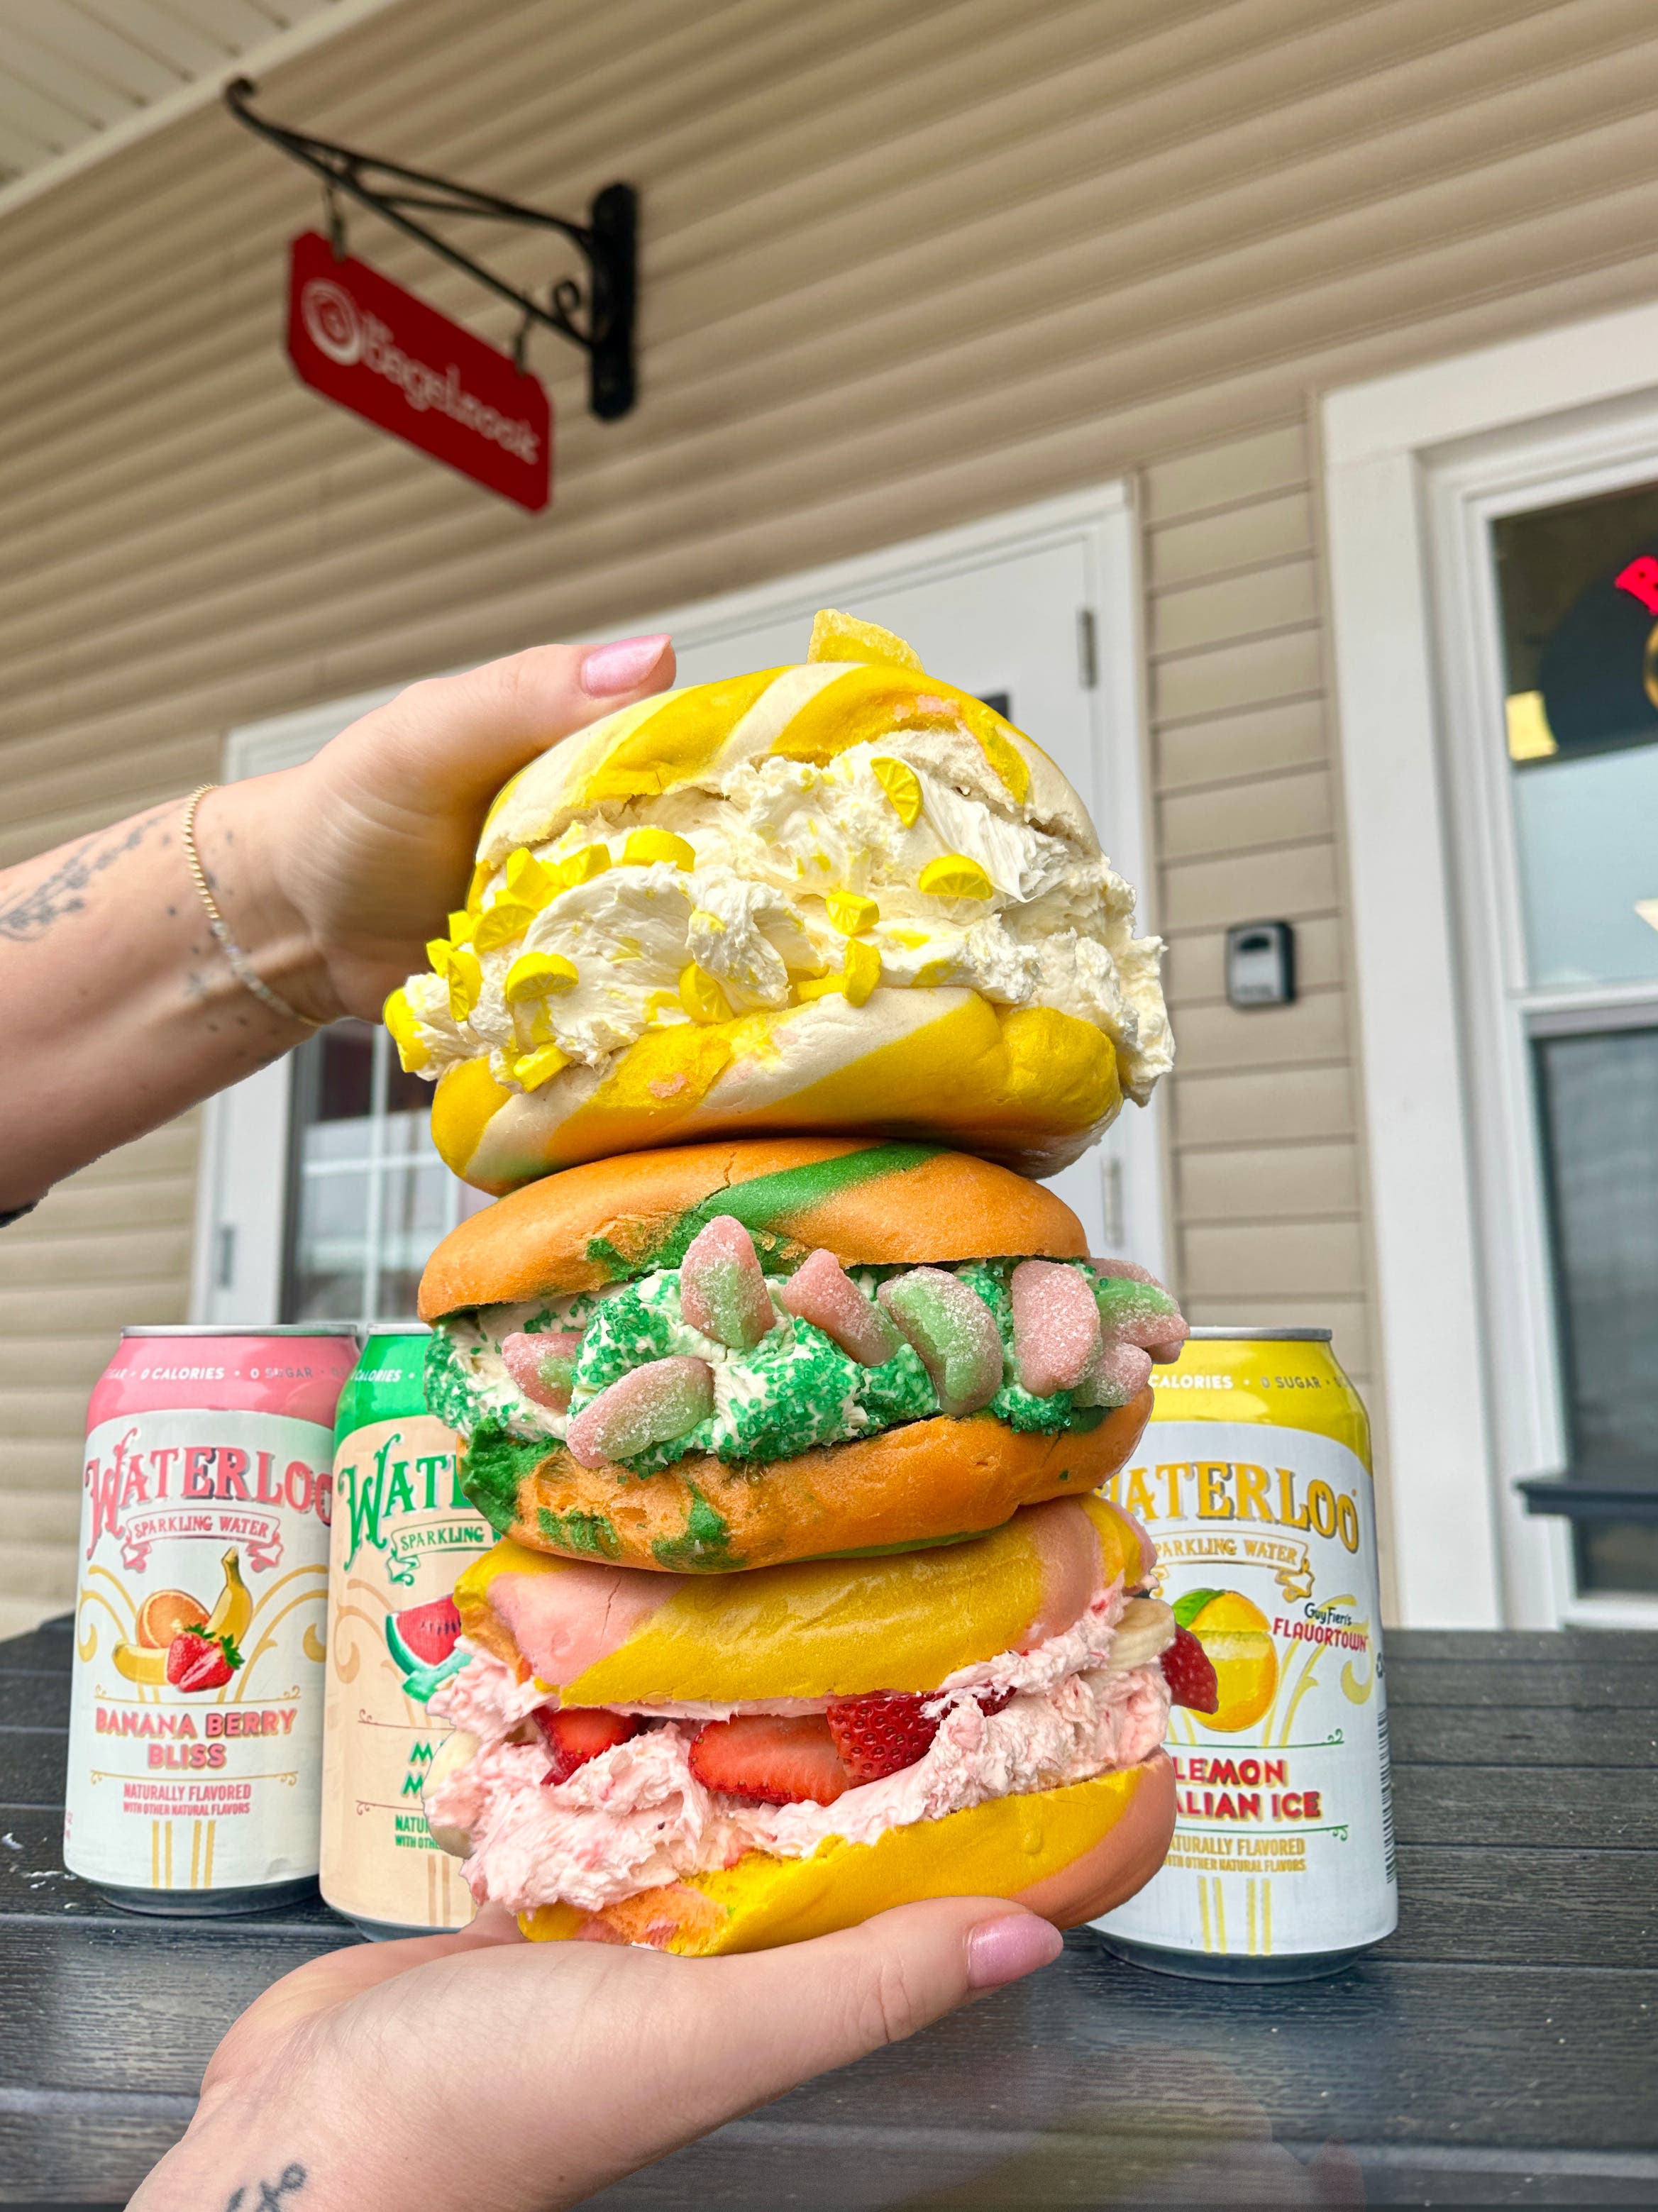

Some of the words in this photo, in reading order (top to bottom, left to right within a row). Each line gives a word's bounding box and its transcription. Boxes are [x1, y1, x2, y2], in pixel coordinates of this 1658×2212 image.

[151, 1366, 225, 1381] CALORIES
[250, 1367, 260, 1379] 0
[1147, 1374, 1234, 1390] CALORIES
[1277, 1375, 1322, 1390] SUGAR
[85, 1427, 332, 1561] WATERLOO
[134, 1515, 213, 1539] SPARKLING
[219, 1516, 269, 1538] WATER
[400, 1527, 485, 1552] SPARKLING
[1156, 1538, 1237, 1559] PARKLING
[1244, 1539, 1298, 1565] WATER
[1304, 1602, 1327, 1625] Guy
[1273, 1617, 1368, 1653] FLAVORTOWN
[95, 1707, 197, 1739] BANANA
[206, 1708, 298, 1737] BERRY
[147, 1743, 228, 1769] BLISS
[1171, 1756, 1288, 1788] LEMON
[123, 1783, 185, 1801] NATURALLY
[188, 1784, 251, 1801] FLAVORED
[123, 1802, 143, 1813] WITH
[143, 1803, 170, 1815] OTHER
[172, 1804, 210, 1815] NATURAL
[211, 1803, 250, 1815] FLAVORS
[1271, 1791, 1322, 1822] ICE
[394, 1834, 416, 1848] WITH
[1237, 1837, 1305, 1857] FLAVORED
[1185, 1856, 1217, 1871] OTHER
[1219, 1857, 1263, 1872] NATURAL
[1264, 1858, 1306, 1872] FLAVORS
